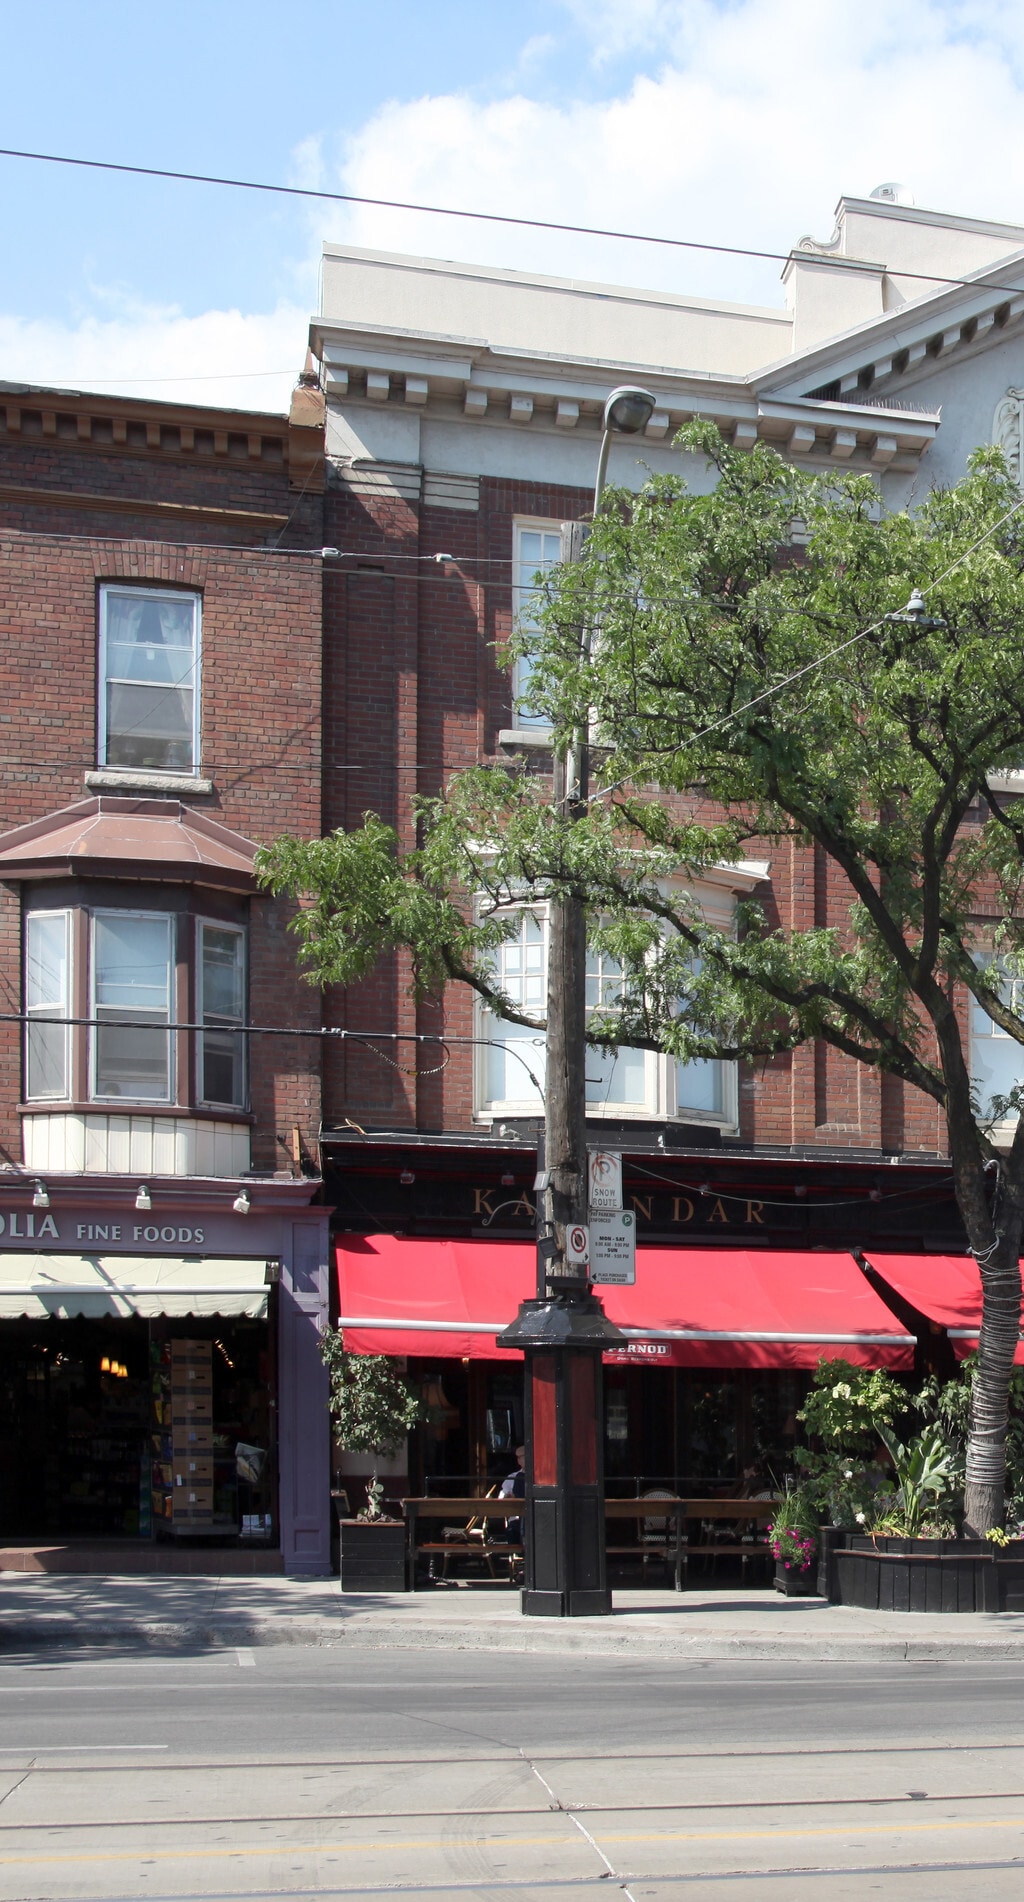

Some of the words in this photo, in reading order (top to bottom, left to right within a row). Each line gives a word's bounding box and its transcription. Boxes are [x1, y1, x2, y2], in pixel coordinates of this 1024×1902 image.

[592, 1198, 617, 1207] ROUTE
[594, 1188, 616, 1197] SNOW
[472, 1188, 765, 1224] KANDAR
[0, 1212, 60, 1238] LIA
[77, 1224, 121, 1240] FINE
[133, 1226, 205, 1243] FOODS
